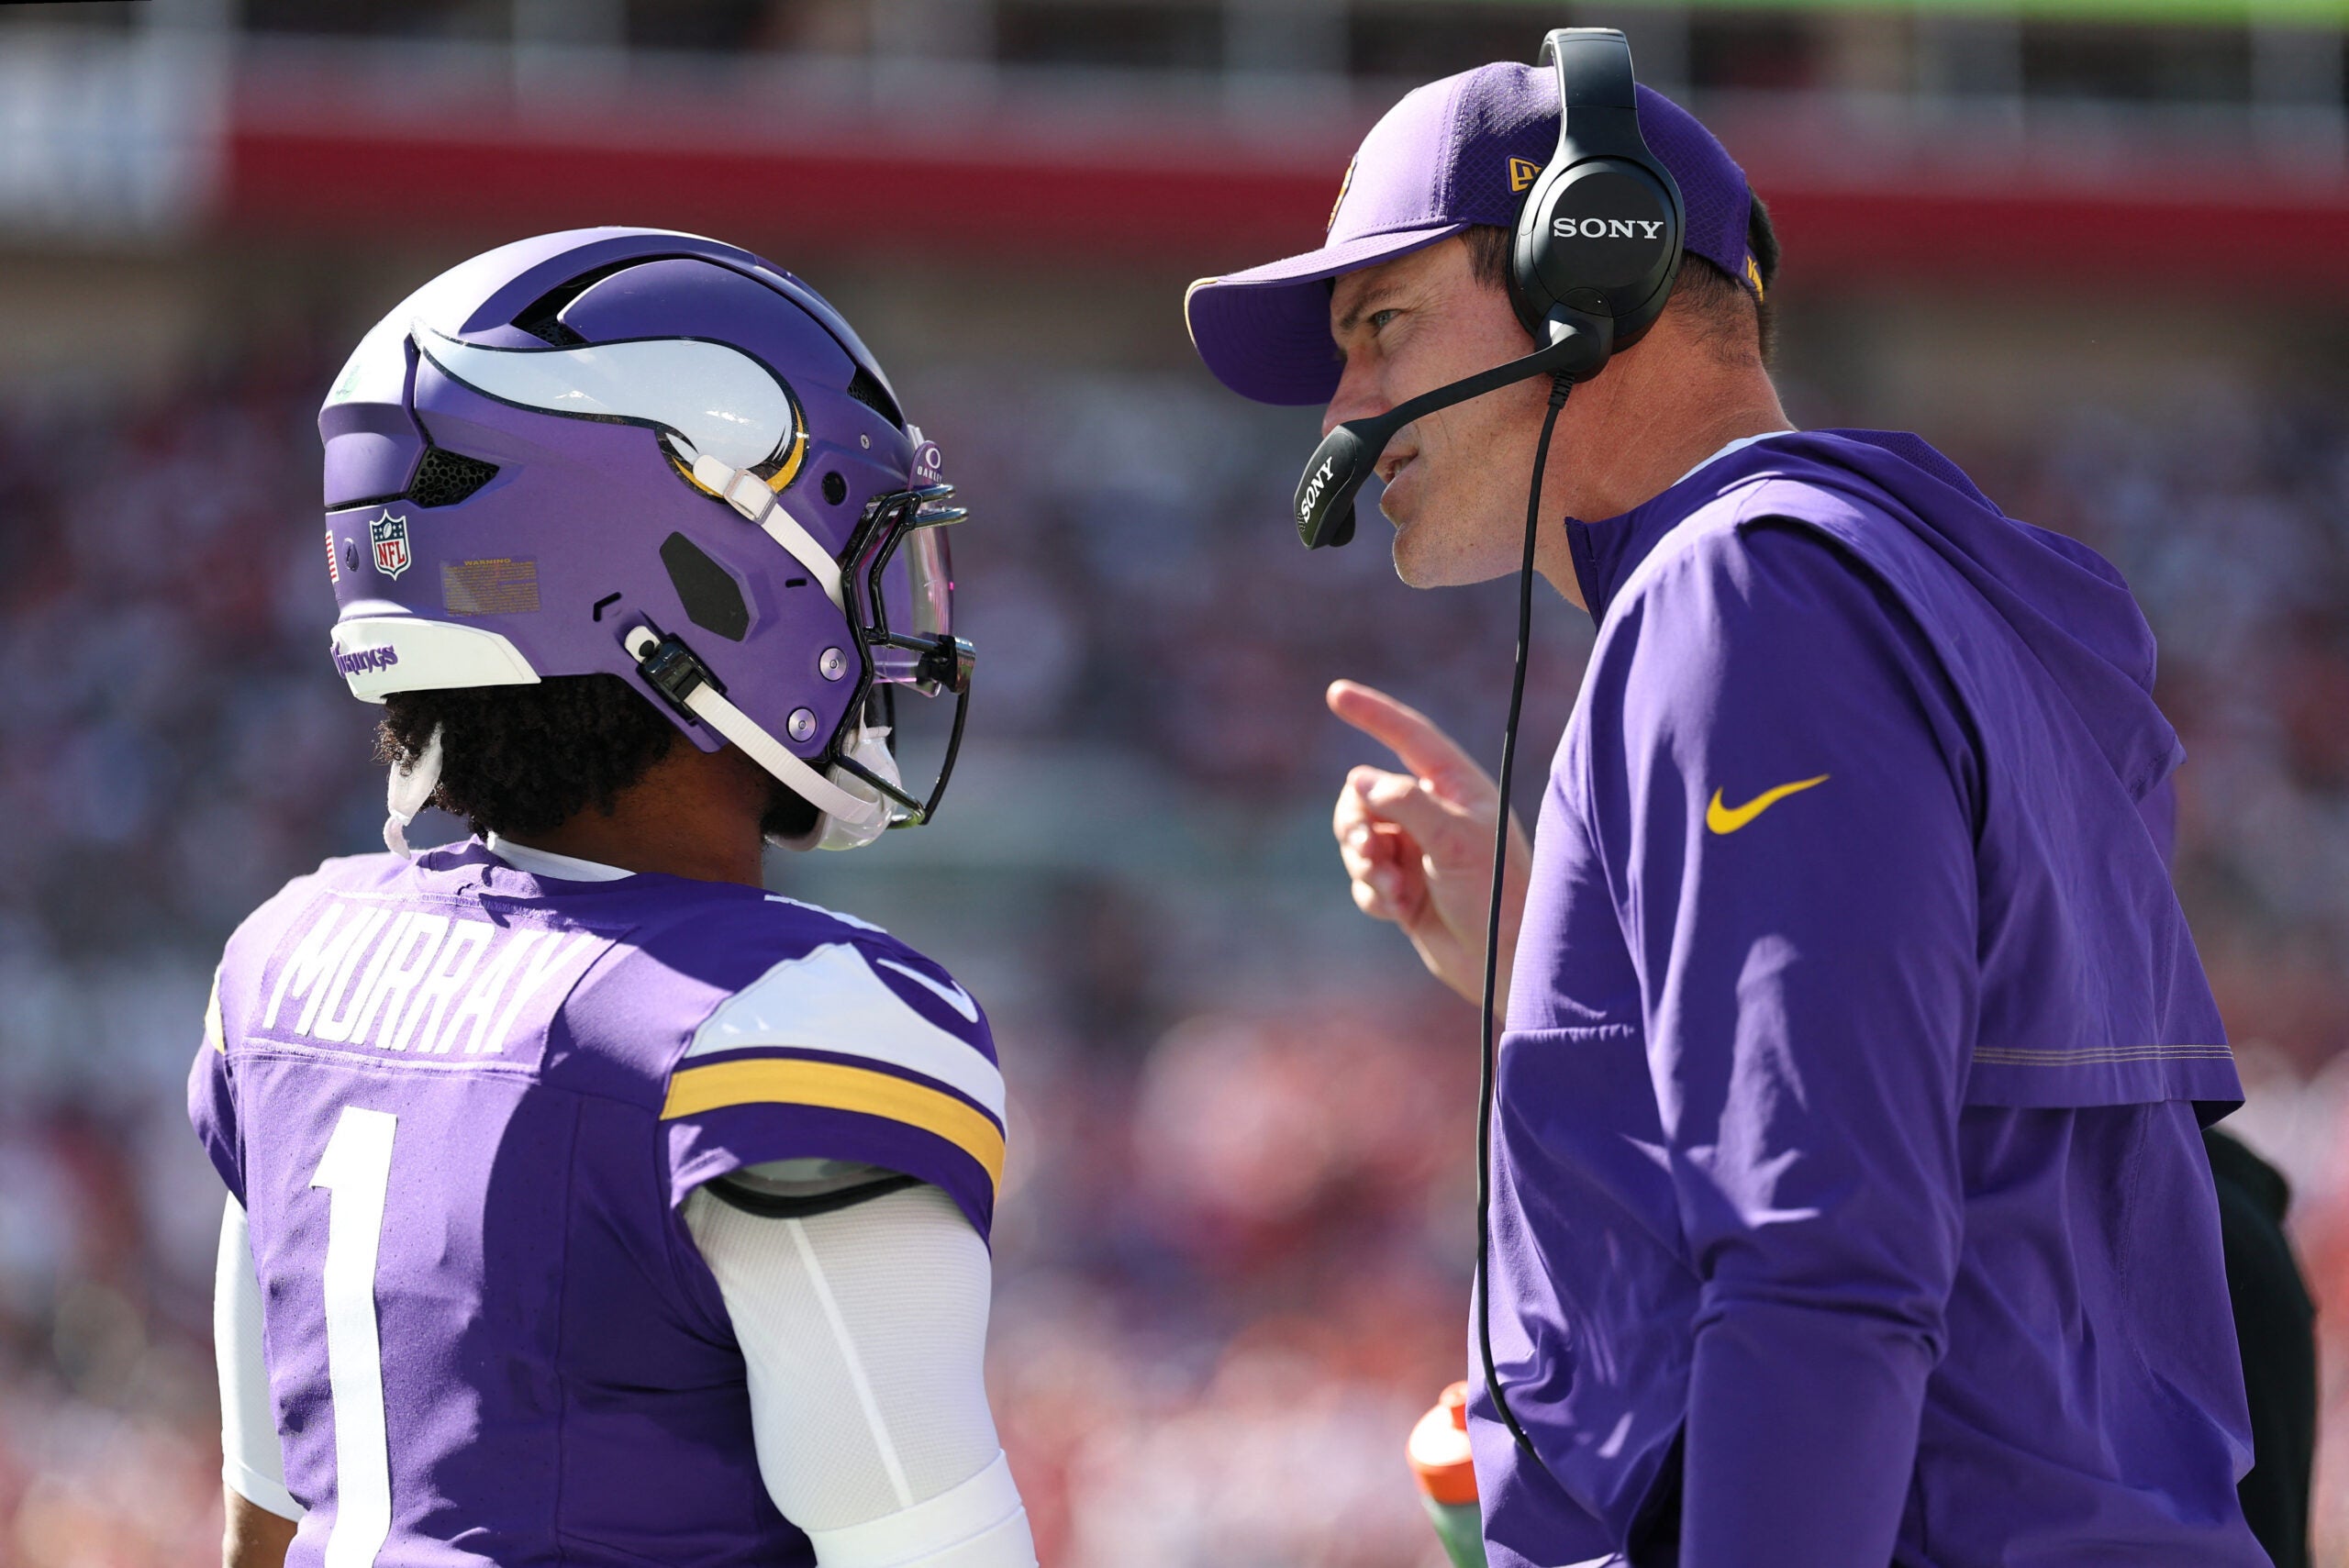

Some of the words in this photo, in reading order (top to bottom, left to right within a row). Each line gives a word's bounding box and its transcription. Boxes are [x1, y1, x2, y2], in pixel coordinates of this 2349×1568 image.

[1553, 217, 1664, 239] SONY
[1301, 456, 1333, 523] SONY
[376, 539, 406, 569] NFL
[463, 558, 511, 566] WARNING
[262, 903, 597, 1053] MURRAY
[308, 1106, 397, 1568] 1
